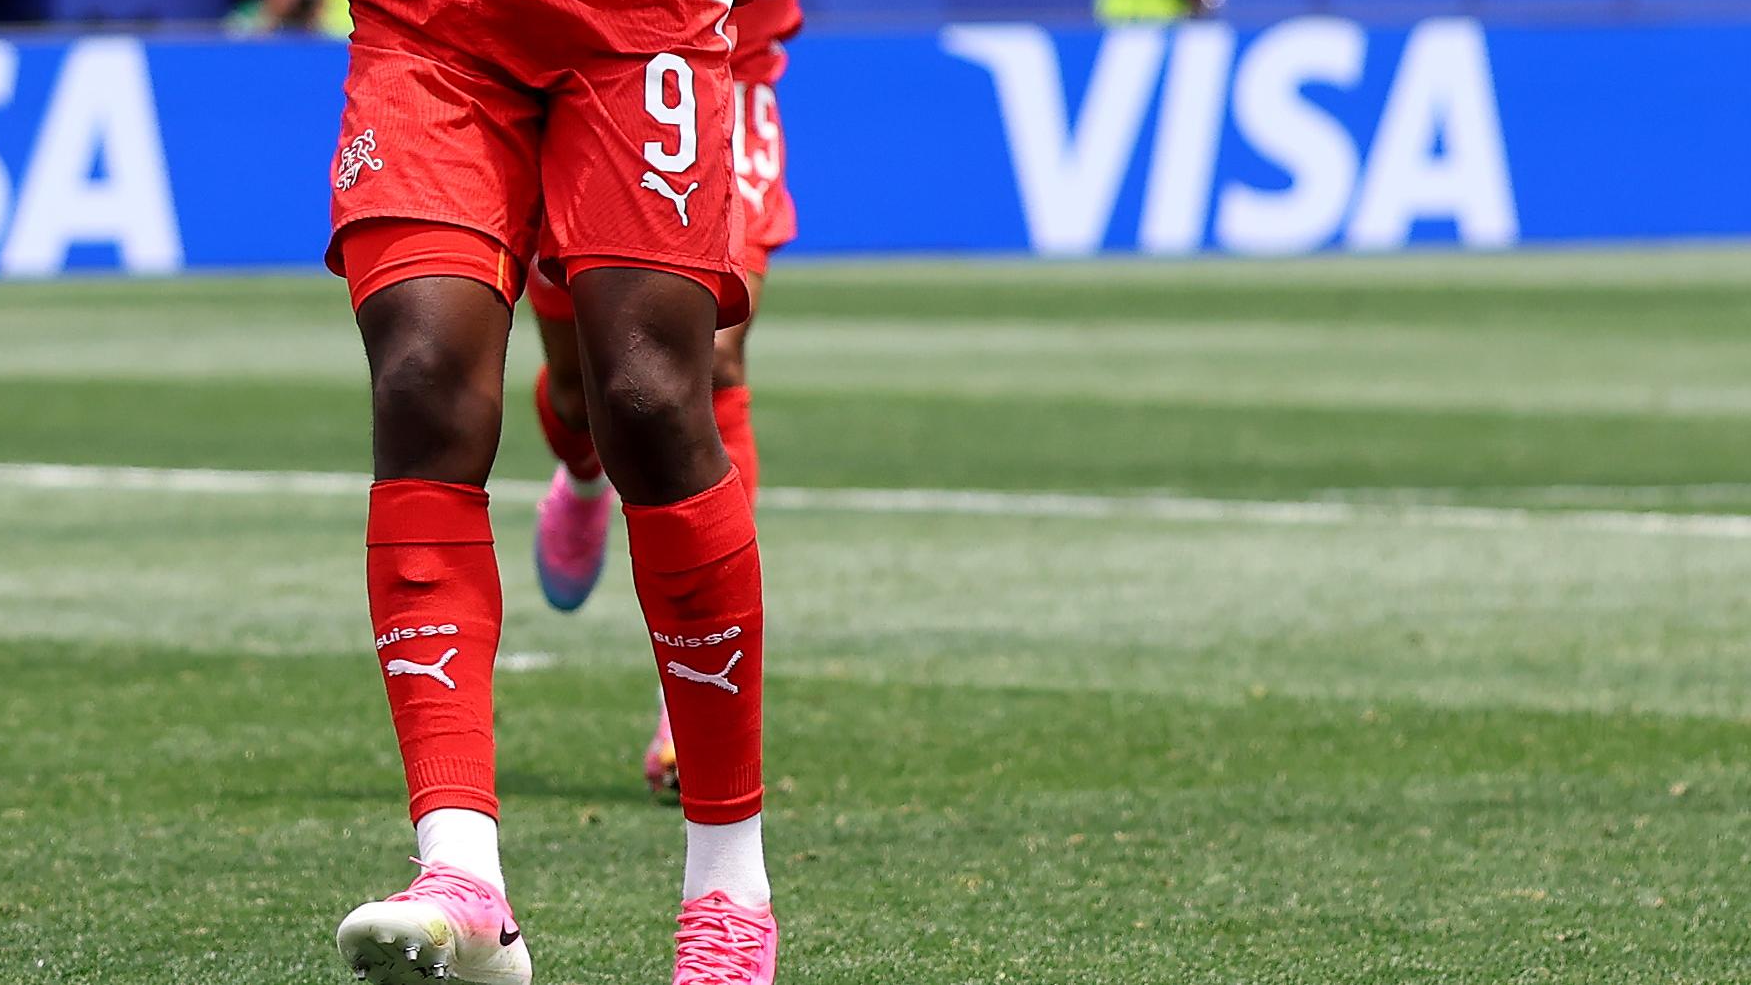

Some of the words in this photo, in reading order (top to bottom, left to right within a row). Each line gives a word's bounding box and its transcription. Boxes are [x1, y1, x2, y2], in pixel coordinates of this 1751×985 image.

[644, 52, 698, 173] 9
[938, 17, 1520, 257] VISA
[376, 624, 459, 649] suisse
[654, 625, 742, 648] suisse
